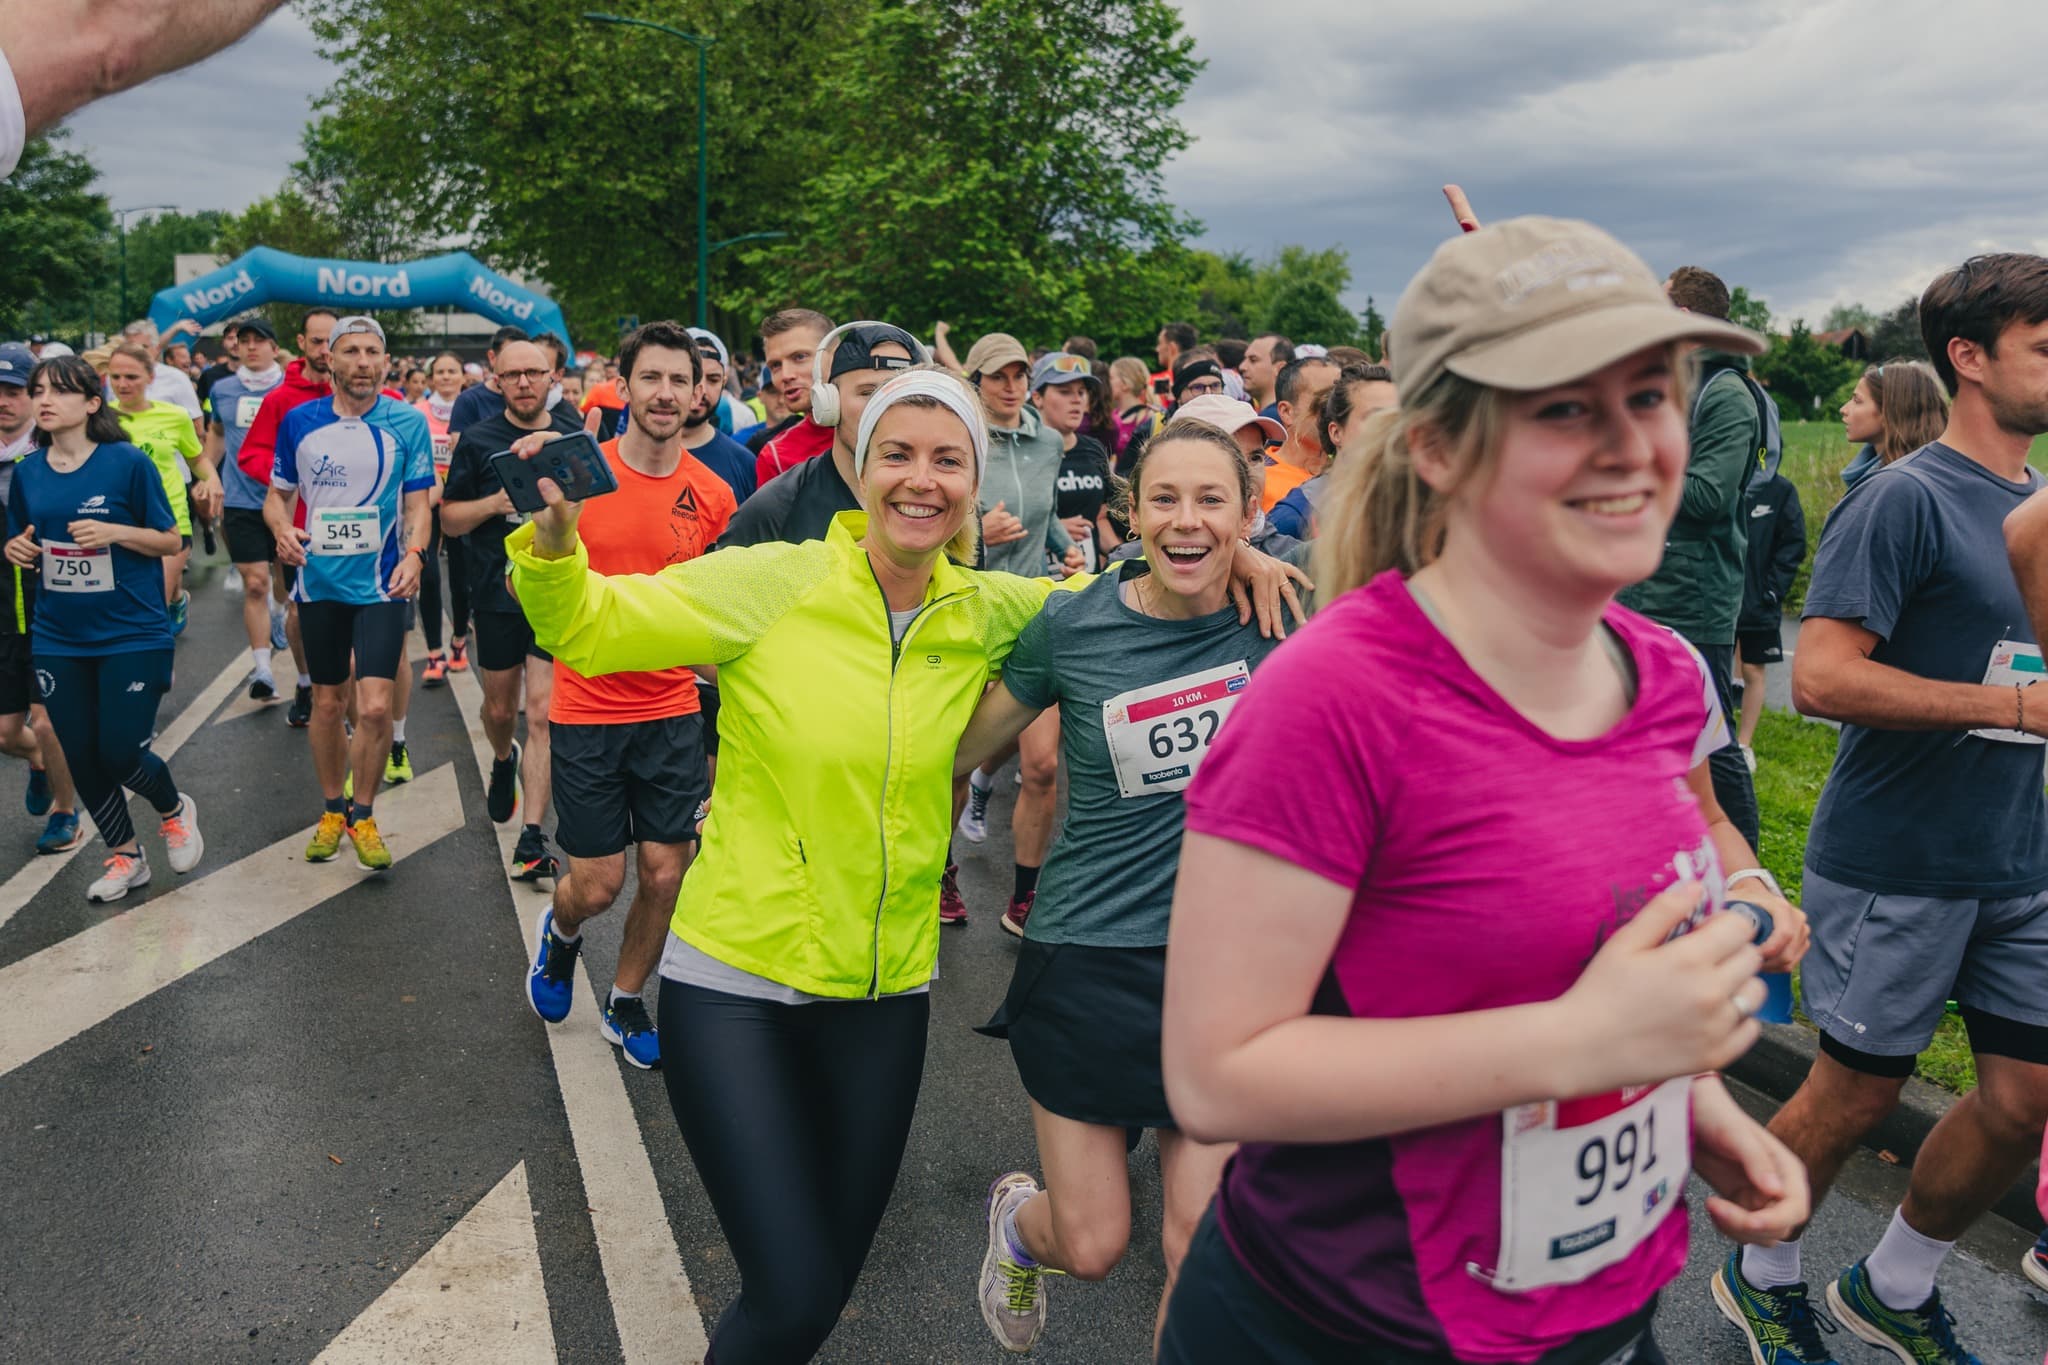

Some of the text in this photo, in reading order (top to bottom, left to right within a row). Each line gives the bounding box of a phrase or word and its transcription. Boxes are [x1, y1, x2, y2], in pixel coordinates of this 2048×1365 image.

[182, 269, 256, 315] Nord
[318, 267, 411, 298] Nord
[469, 276, 535, 321] Nord
[327, 523, 363, 540] 545
[55, 559, 92, 576] 750
[1172, 696, 1184, 708] 10
[1185, 691, 1202, 704] KM
[1148, 709, 1220, 759] 632
[1575, 1105, 1657, 1207] 991
